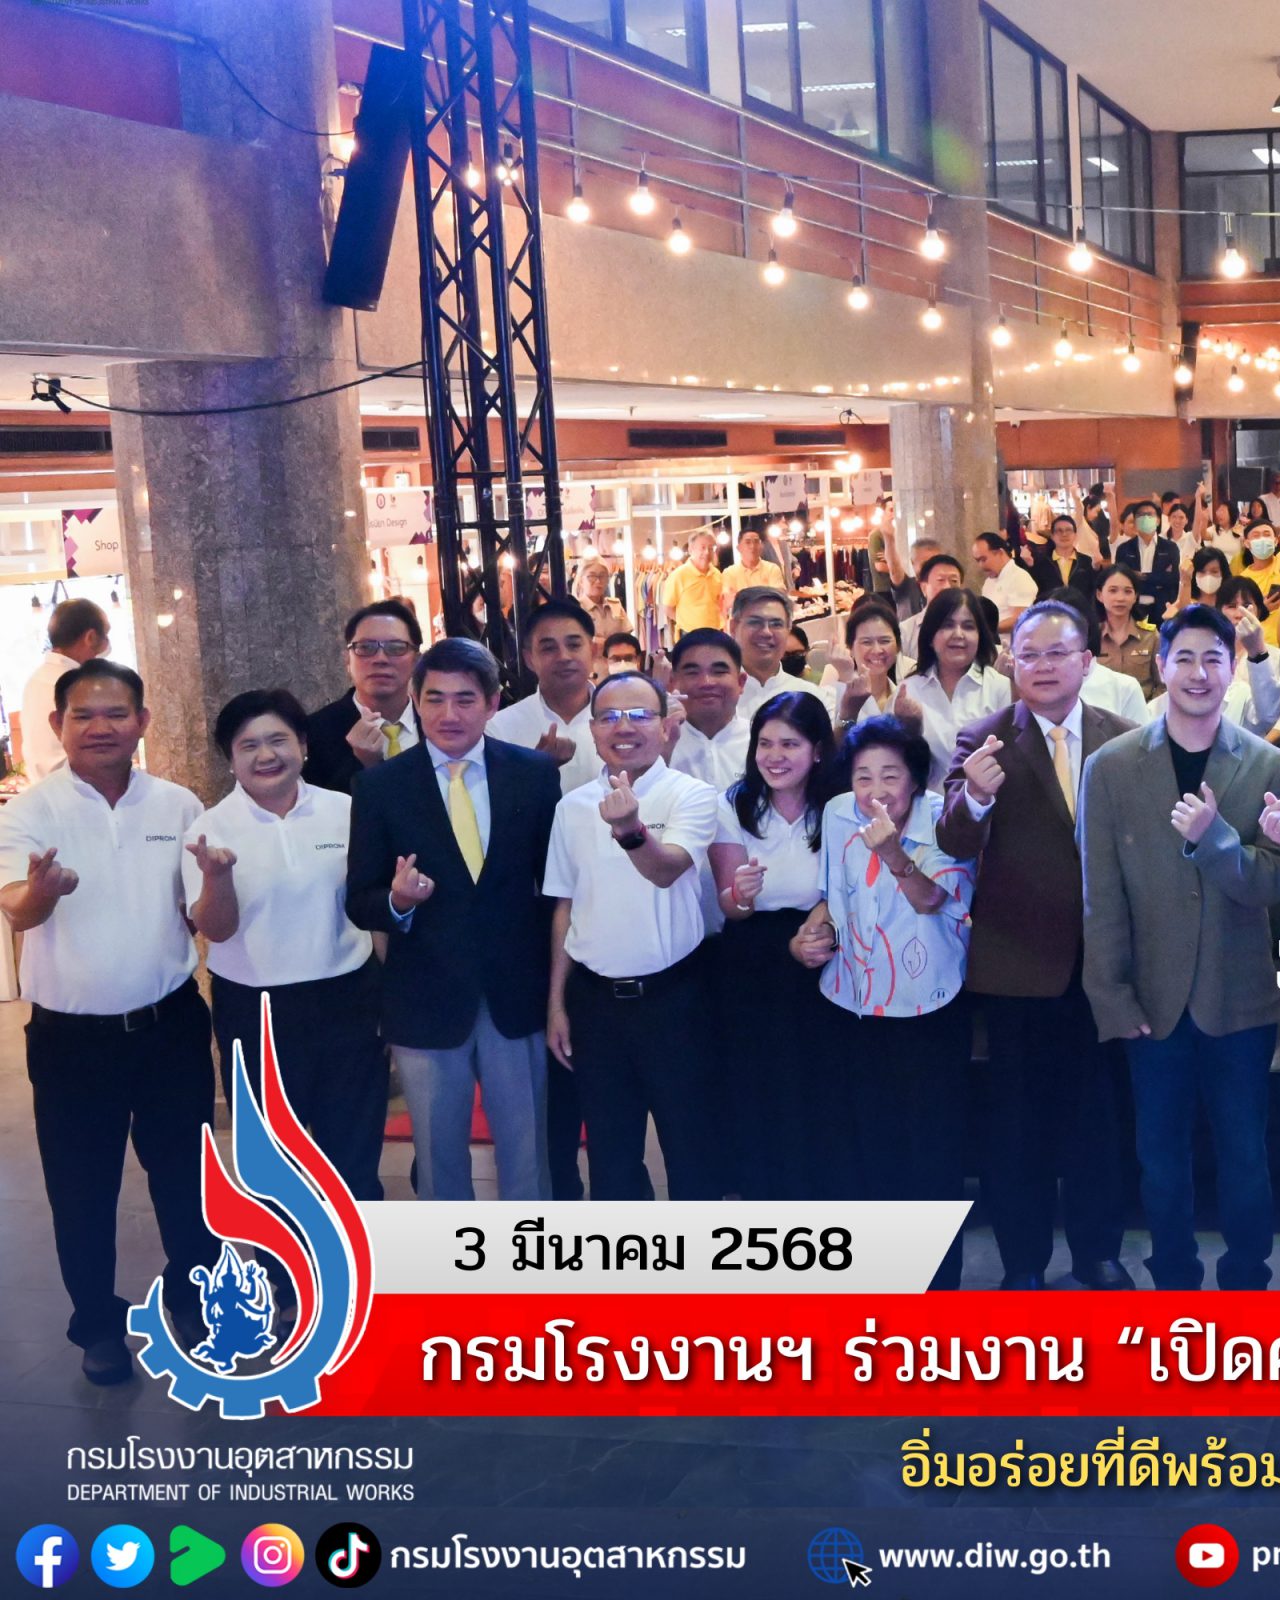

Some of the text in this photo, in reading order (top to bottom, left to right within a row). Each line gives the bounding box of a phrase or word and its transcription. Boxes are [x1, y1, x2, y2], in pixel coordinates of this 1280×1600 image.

[94, 539, 119, 553] Shop
[145, 834, 177, 842] DIPROM
[315, 842, 345, 851] DIPROM
